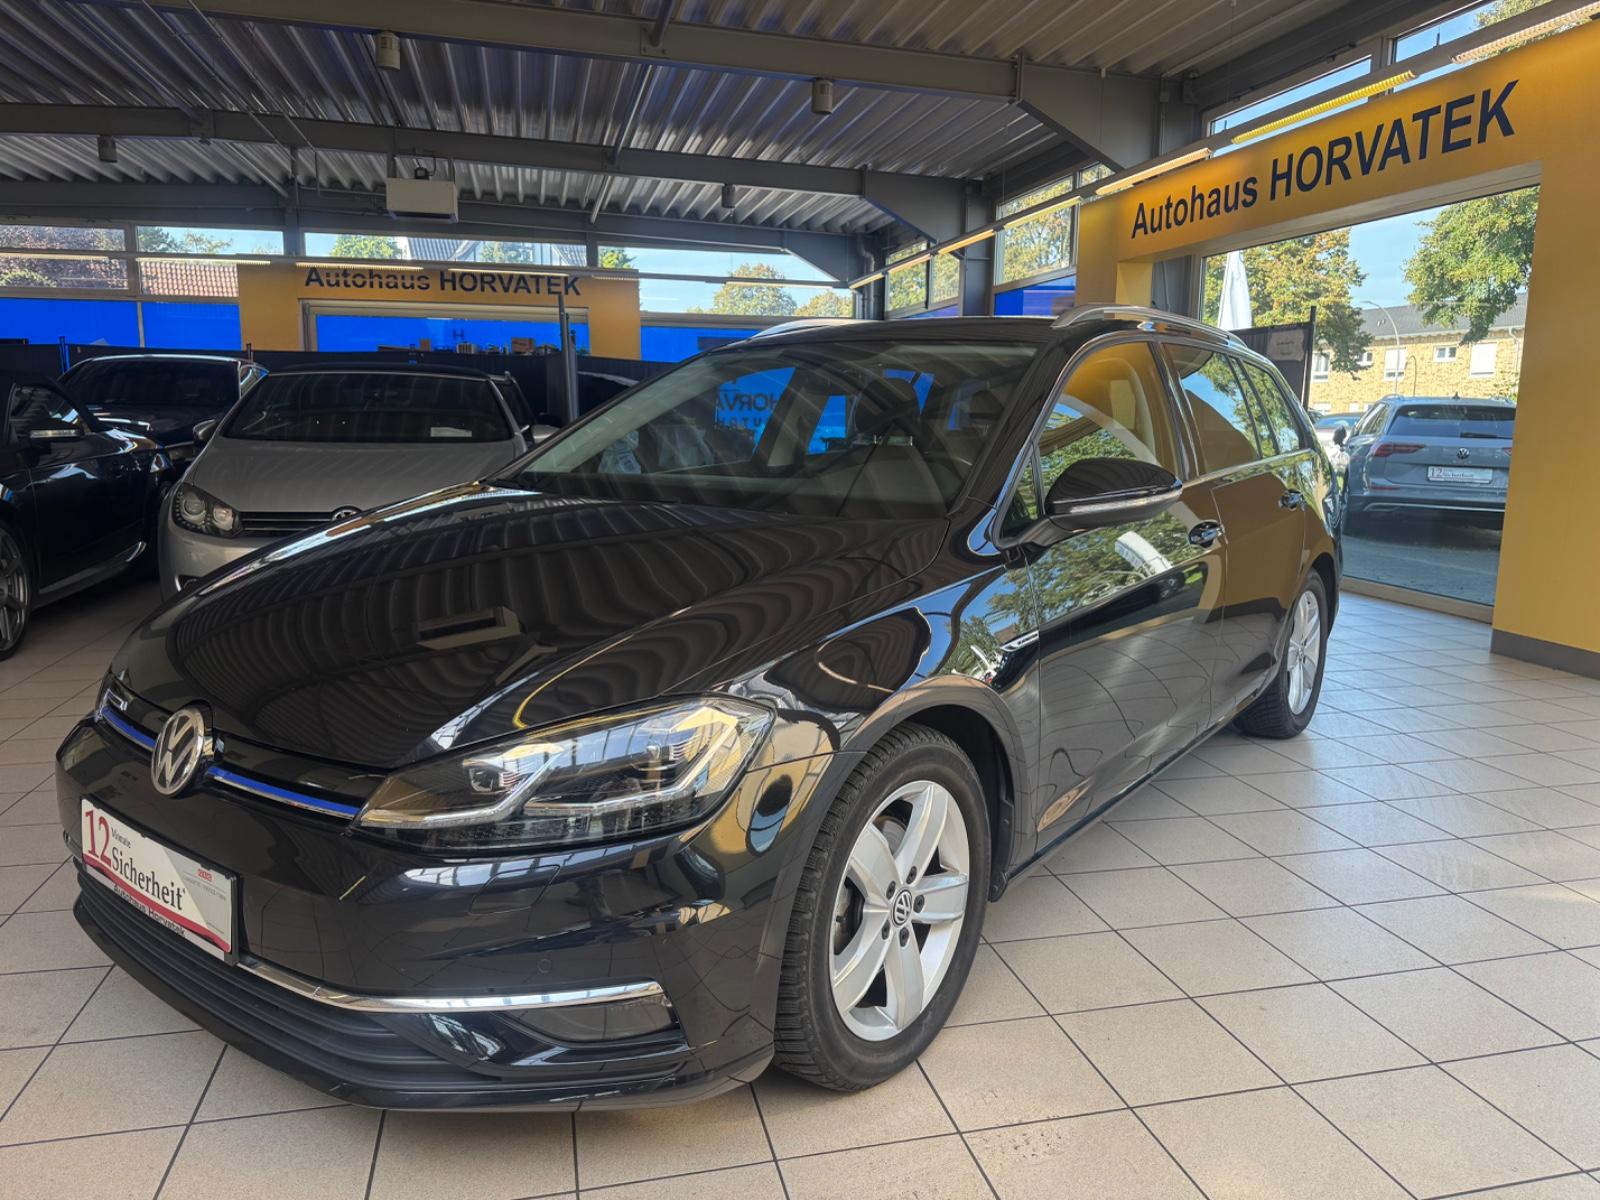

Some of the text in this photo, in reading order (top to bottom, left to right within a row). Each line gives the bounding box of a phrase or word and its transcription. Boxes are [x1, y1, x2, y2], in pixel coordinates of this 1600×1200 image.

[1131, 79, 1520, 239] Autohaus HORVATEK
[305, 267, 581, 296] Autohaus HORVATEK
[85, 810, 112, 867] 12
